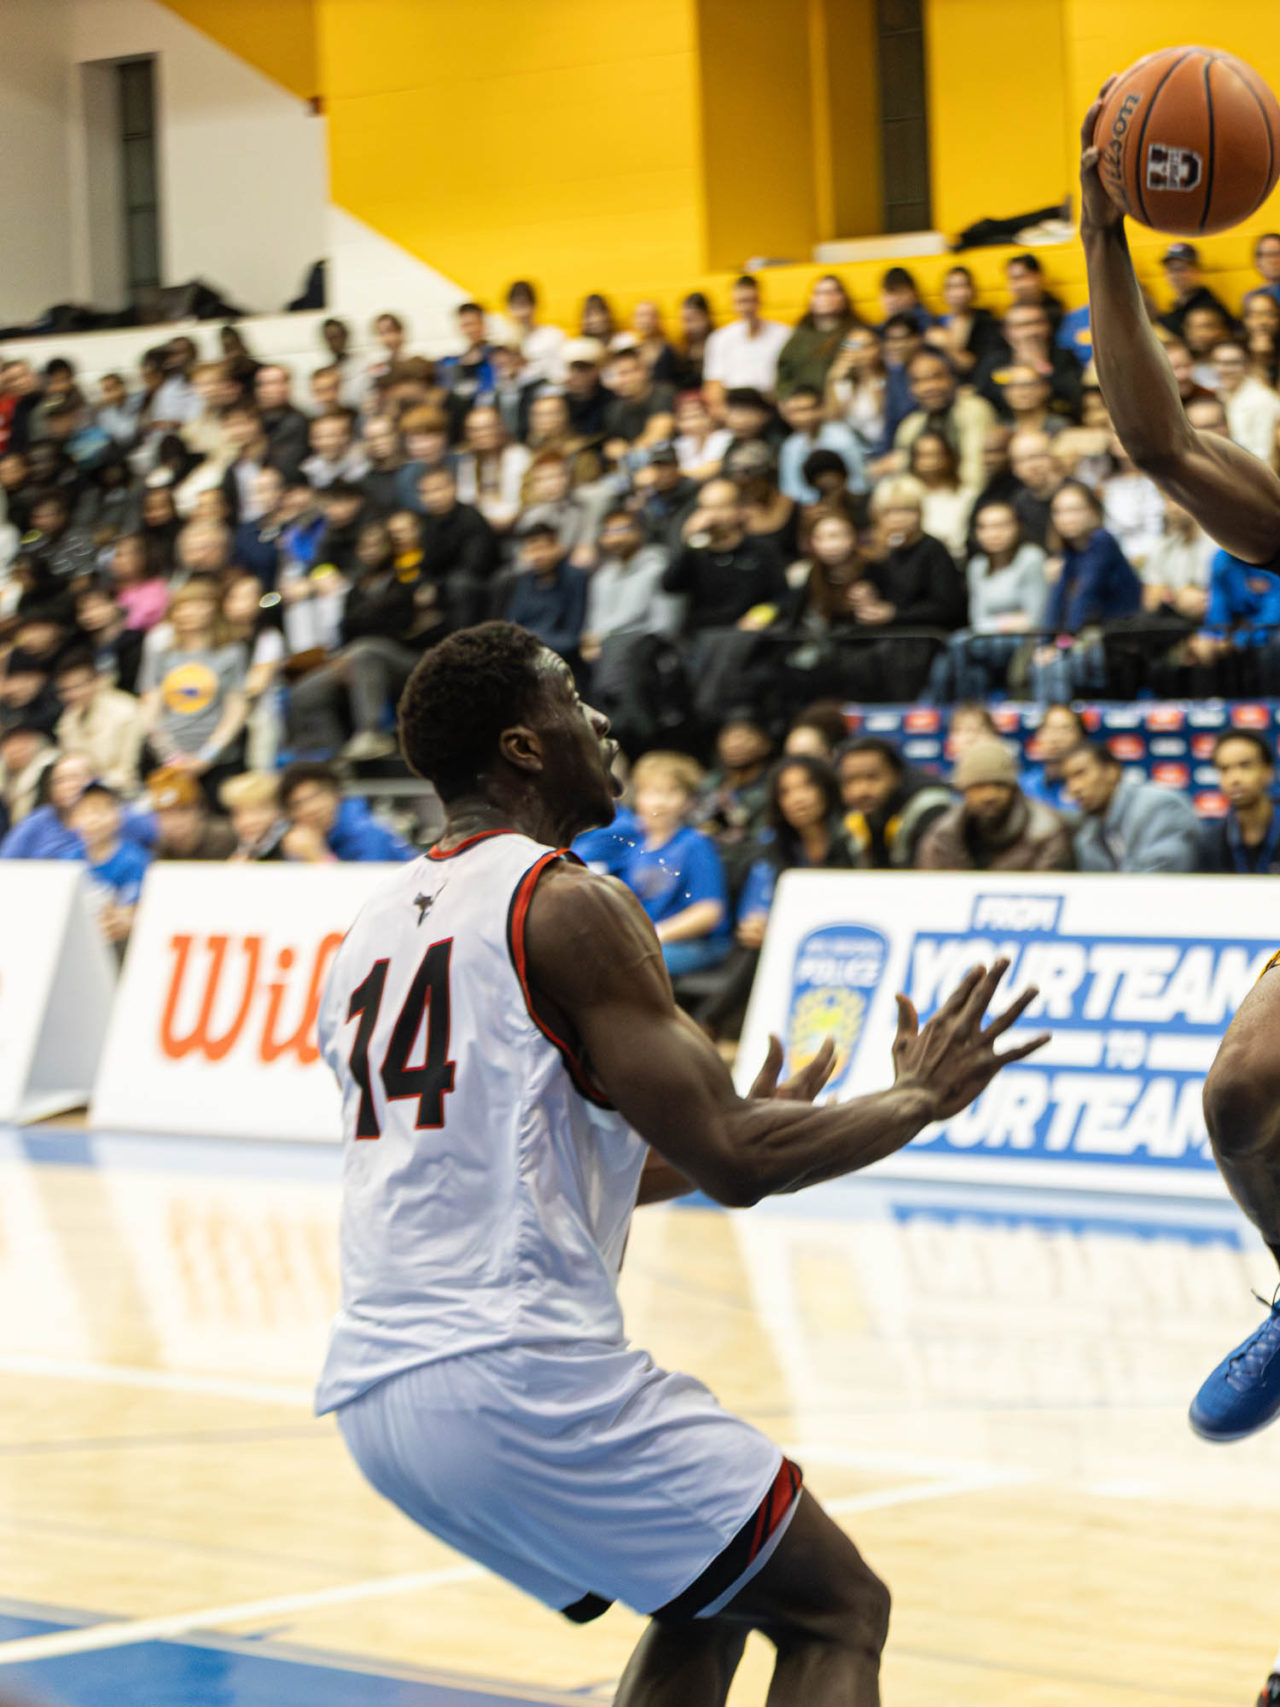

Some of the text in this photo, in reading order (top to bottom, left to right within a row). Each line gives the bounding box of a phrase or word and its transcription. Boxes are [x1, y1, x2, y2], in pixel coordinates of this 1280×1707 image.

[974, 902, 1056, 931] FROM
[797, 958, 881, 987] POLICE
[346, 936, 457, 1141] 14
[1106, 1029, 1147, 1070] TO
[908, 1069, 1050, 1150] UR
